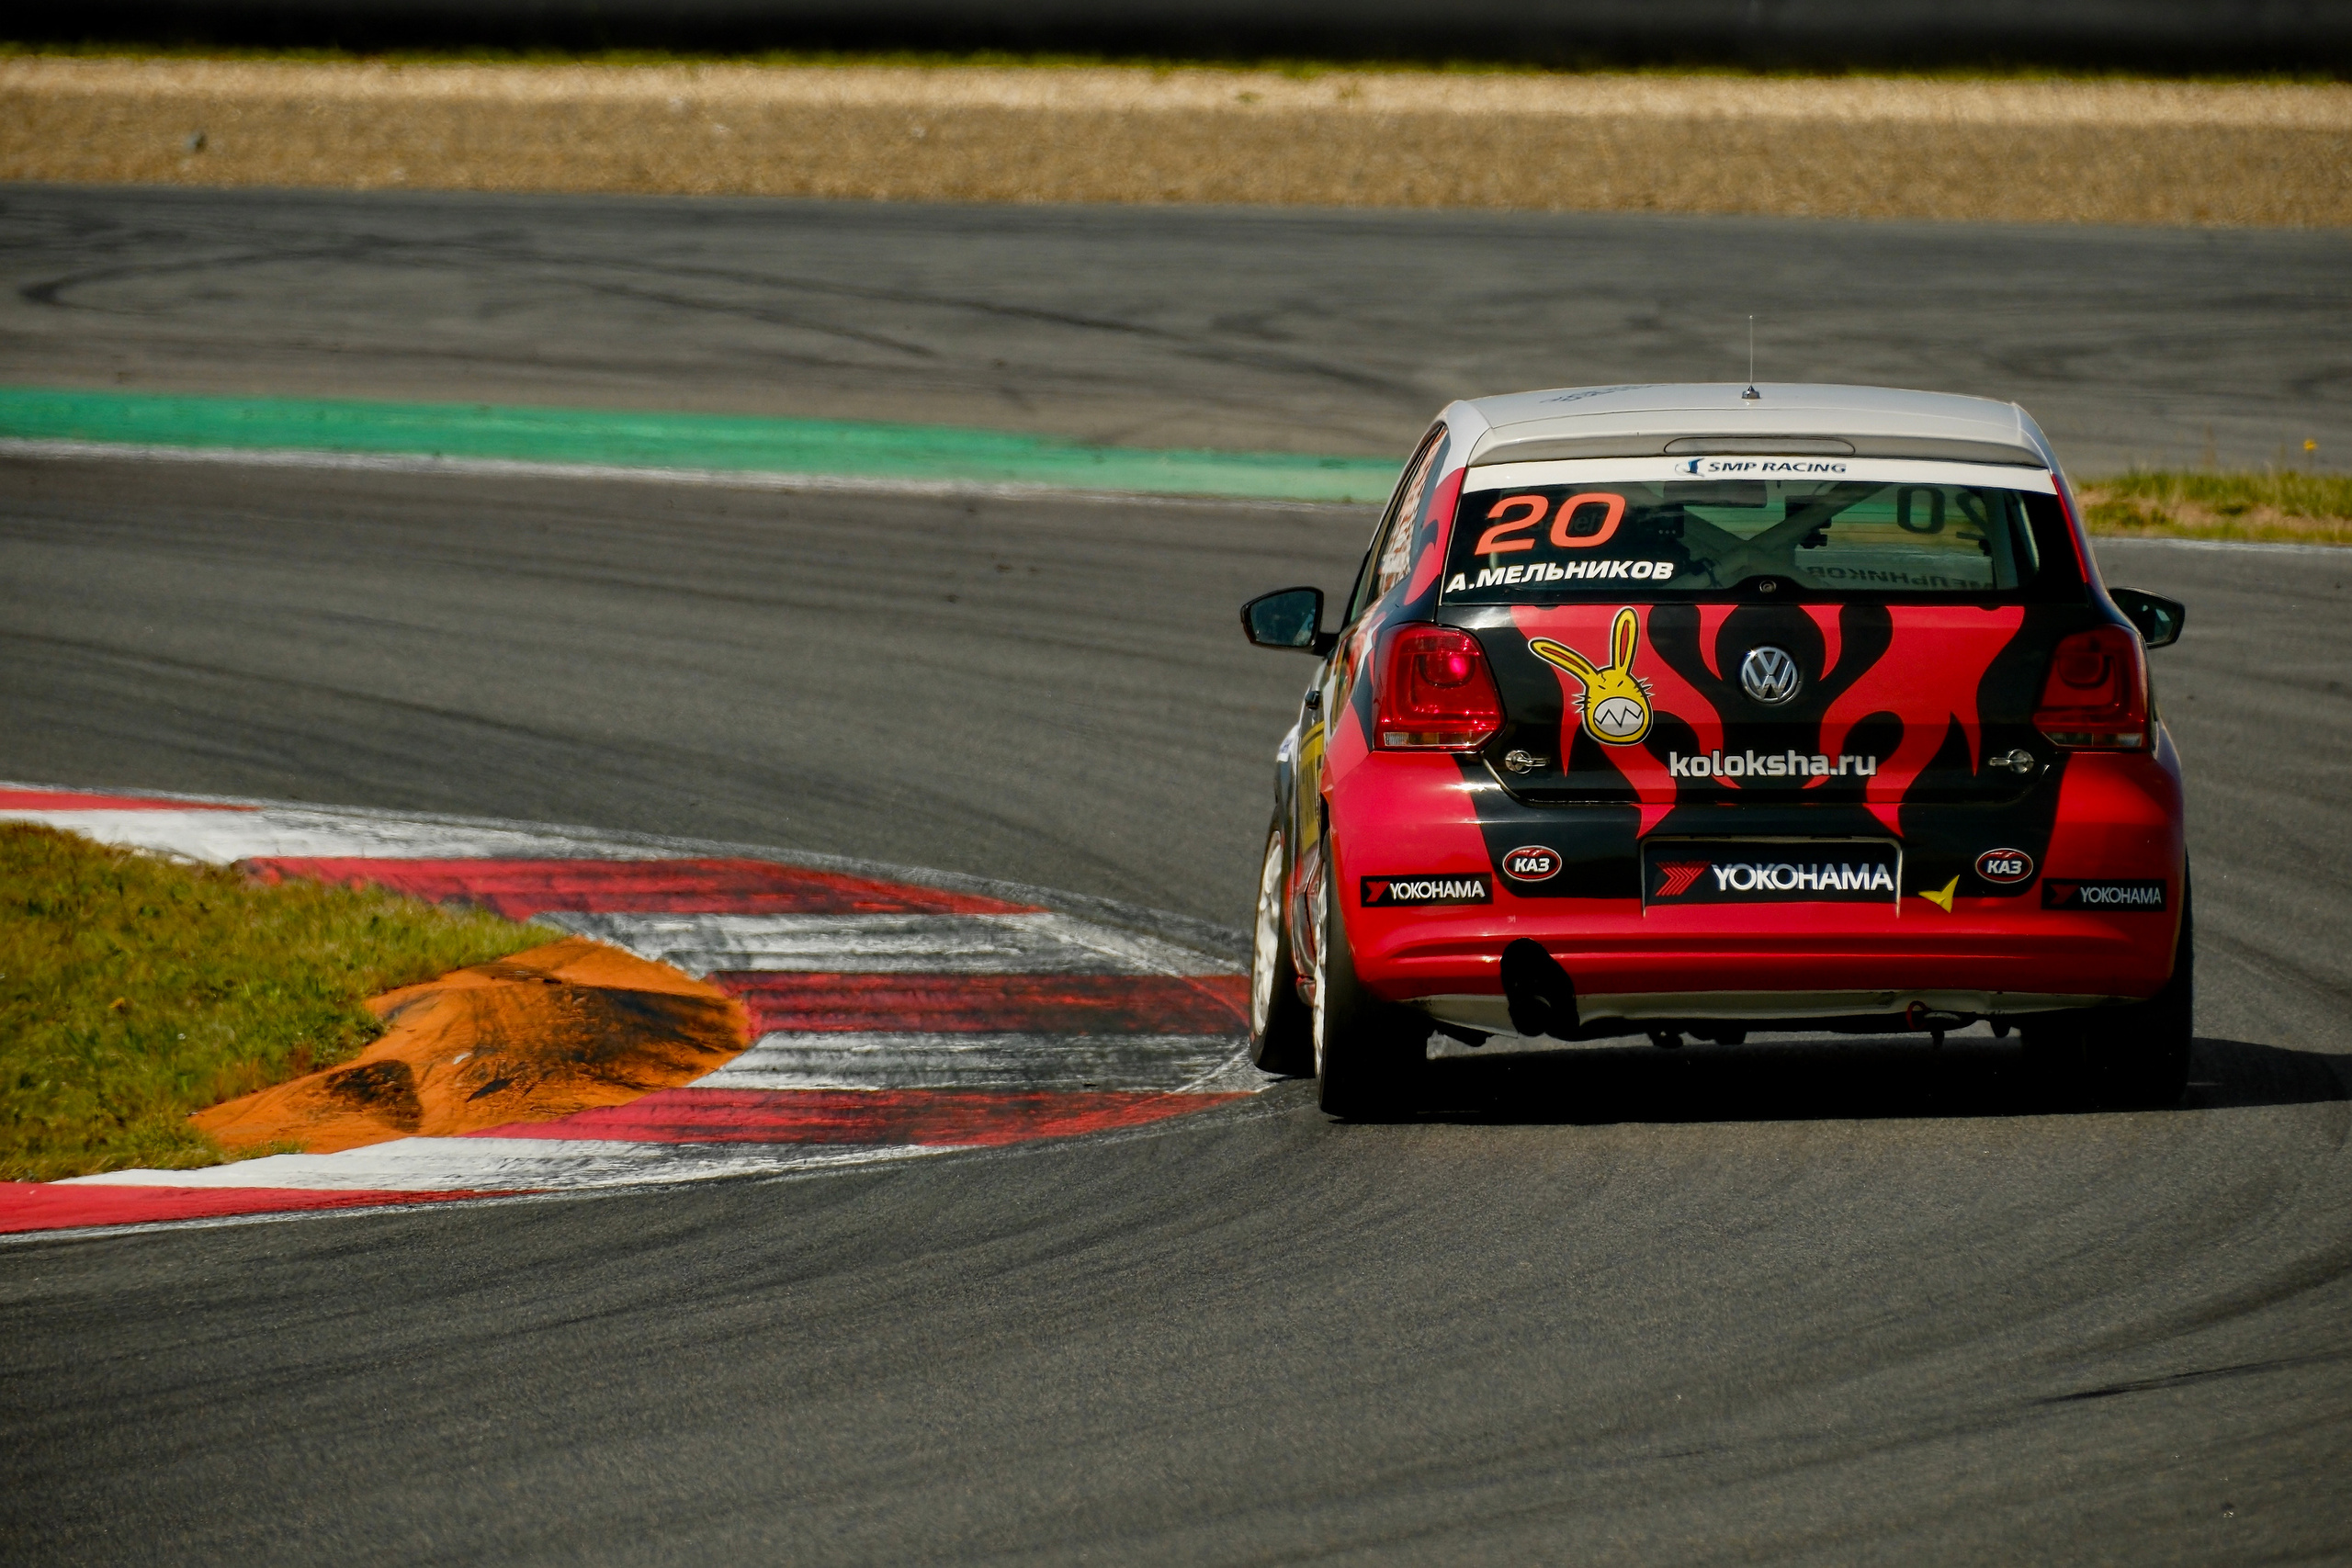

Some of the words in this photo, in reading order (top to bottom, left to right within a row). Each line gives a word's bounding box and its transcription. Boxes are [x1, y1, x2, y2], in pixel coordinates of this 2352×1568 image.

[1707, 462, 1757, 472] SMP
[1761, 462, 1847, 474] RACING
[1474, 491, 1626, 556] 20
[1445, 559, 1674, 593] А.МЕЛЬНИКОВ
[1669, 749, 1878, 777] koloksha.ru
[1389, 880, 1486, 901] YOKOHAMA
[1711, 863, 1894, 892] YOKOHAMA
[2080, 886, 2162, 905] YOKOHAMA
